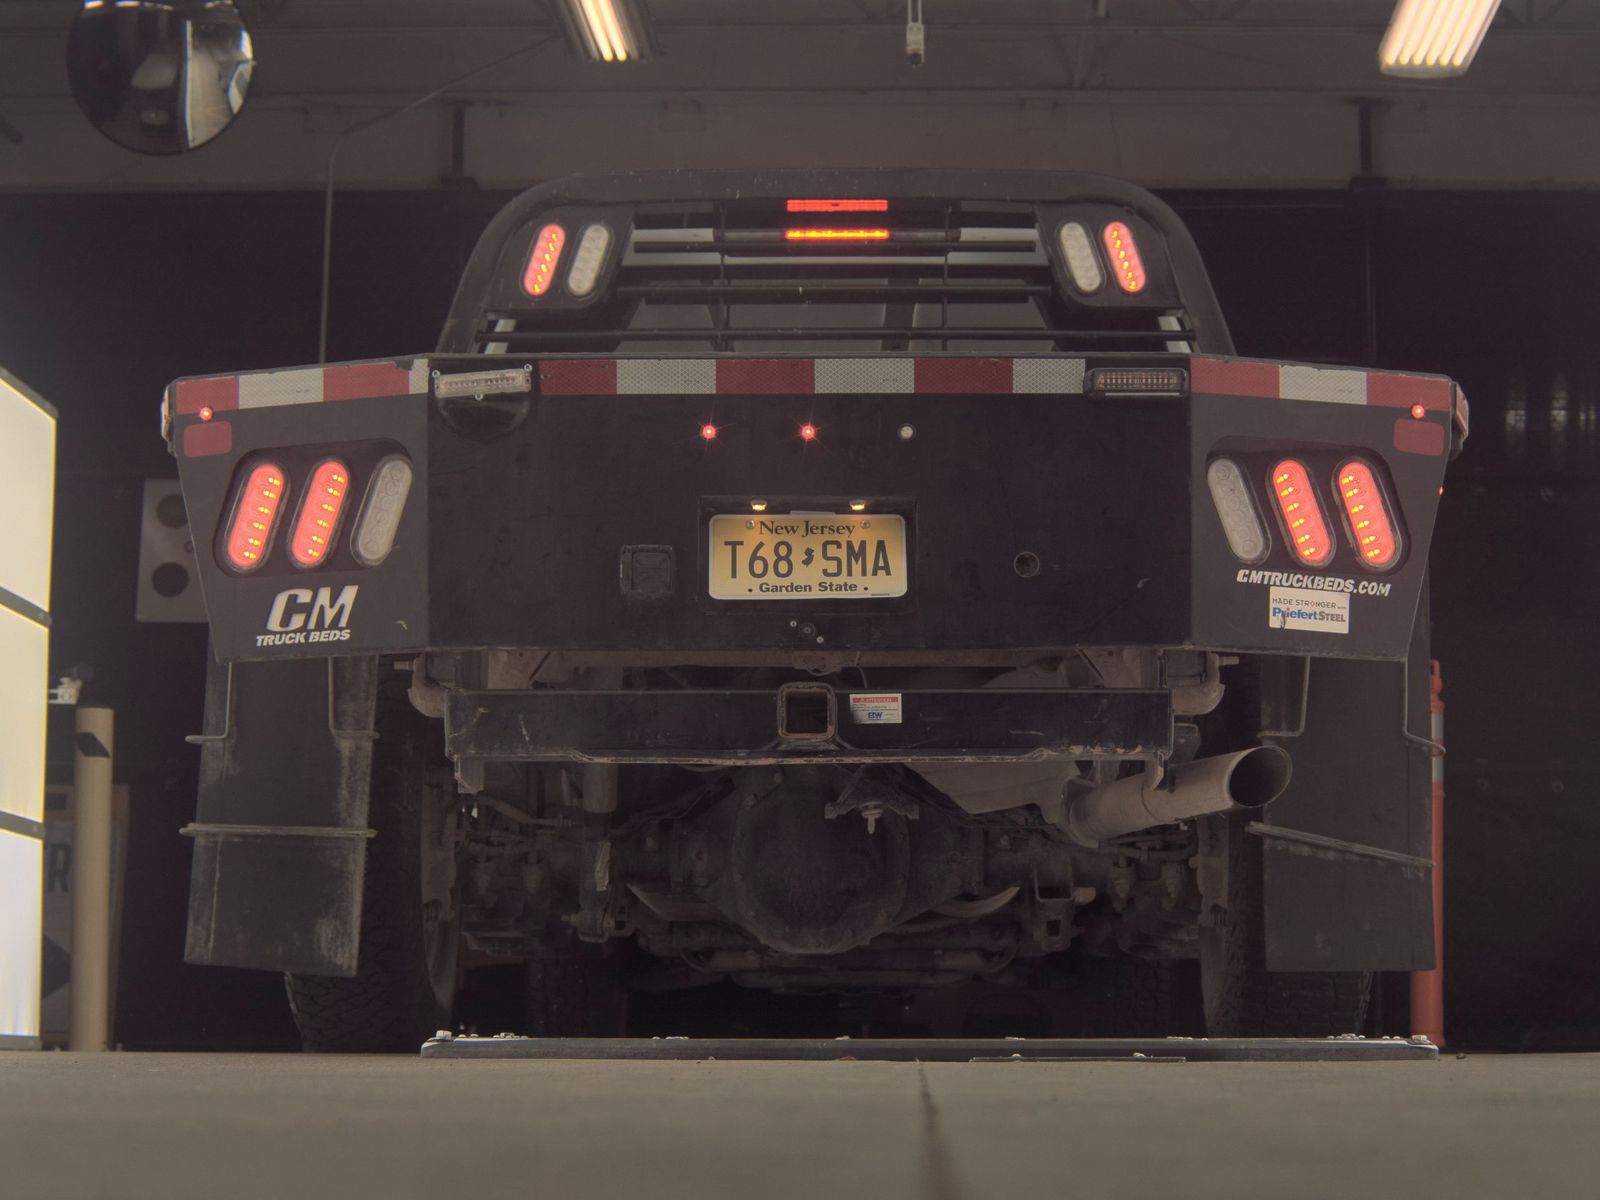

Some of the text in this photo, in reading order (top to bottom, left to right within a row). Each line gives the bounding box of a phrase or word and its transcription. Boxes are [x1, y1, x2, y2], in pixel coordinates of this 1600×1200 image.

[759, 520, 856, 537] New Jersey
[724, 539, 892, 579] T68 SMA
[758, 581, 858, 593] Garden State
[1236, 569, 1391, 597] CMTRUCKBEDS.COM
[266, 585, 359, 632] CM
[1295, 600, 1337, 609] STRONGER
[256, 629, 351, 646] TRUCK BEDS
